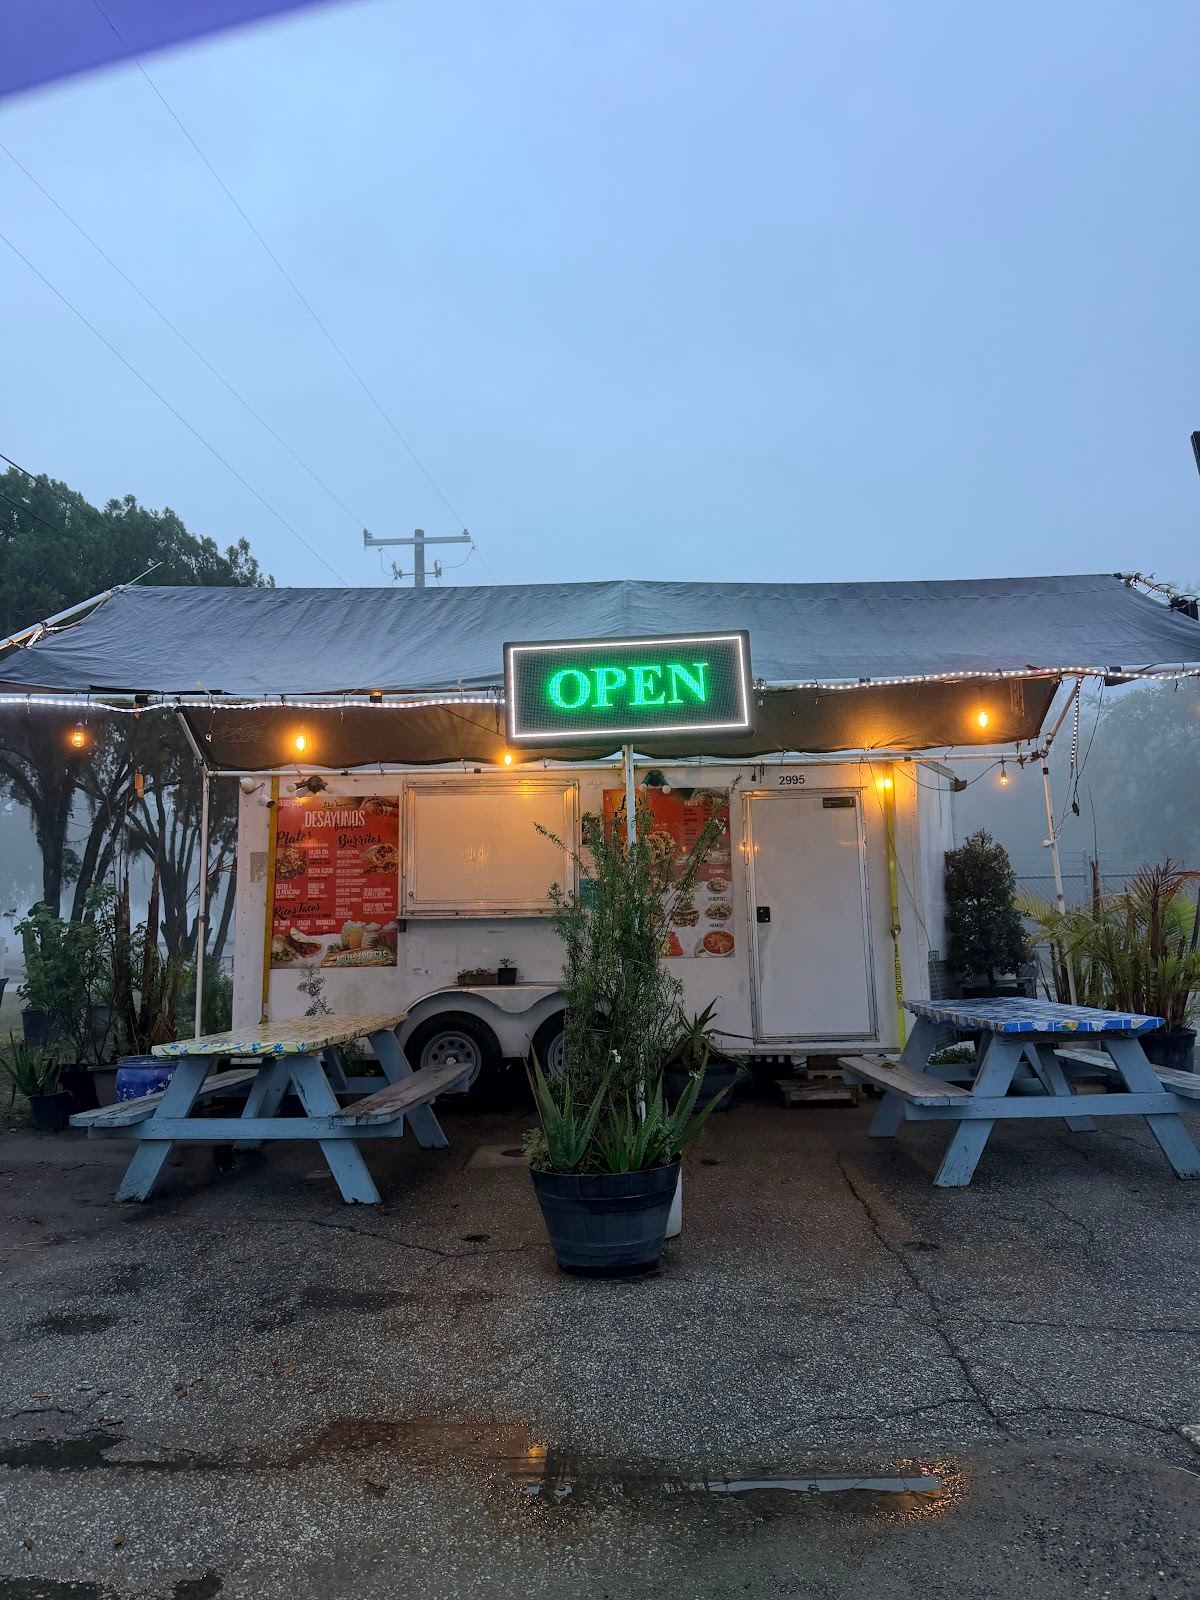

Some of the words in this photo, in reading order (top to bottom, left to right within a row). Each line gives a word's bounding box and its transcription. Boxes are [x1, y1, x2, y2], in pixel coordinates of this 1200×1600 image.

[548, 662, 709, 709] OPEN
[778, 774, 805, 785] 2995
[304, 810, 366, 828] DESAYUNOS
[277, 829, 313, 845] Platos
[337, 832, 382, 848] Burritos
[298, 903, 321, 913] Tacos
